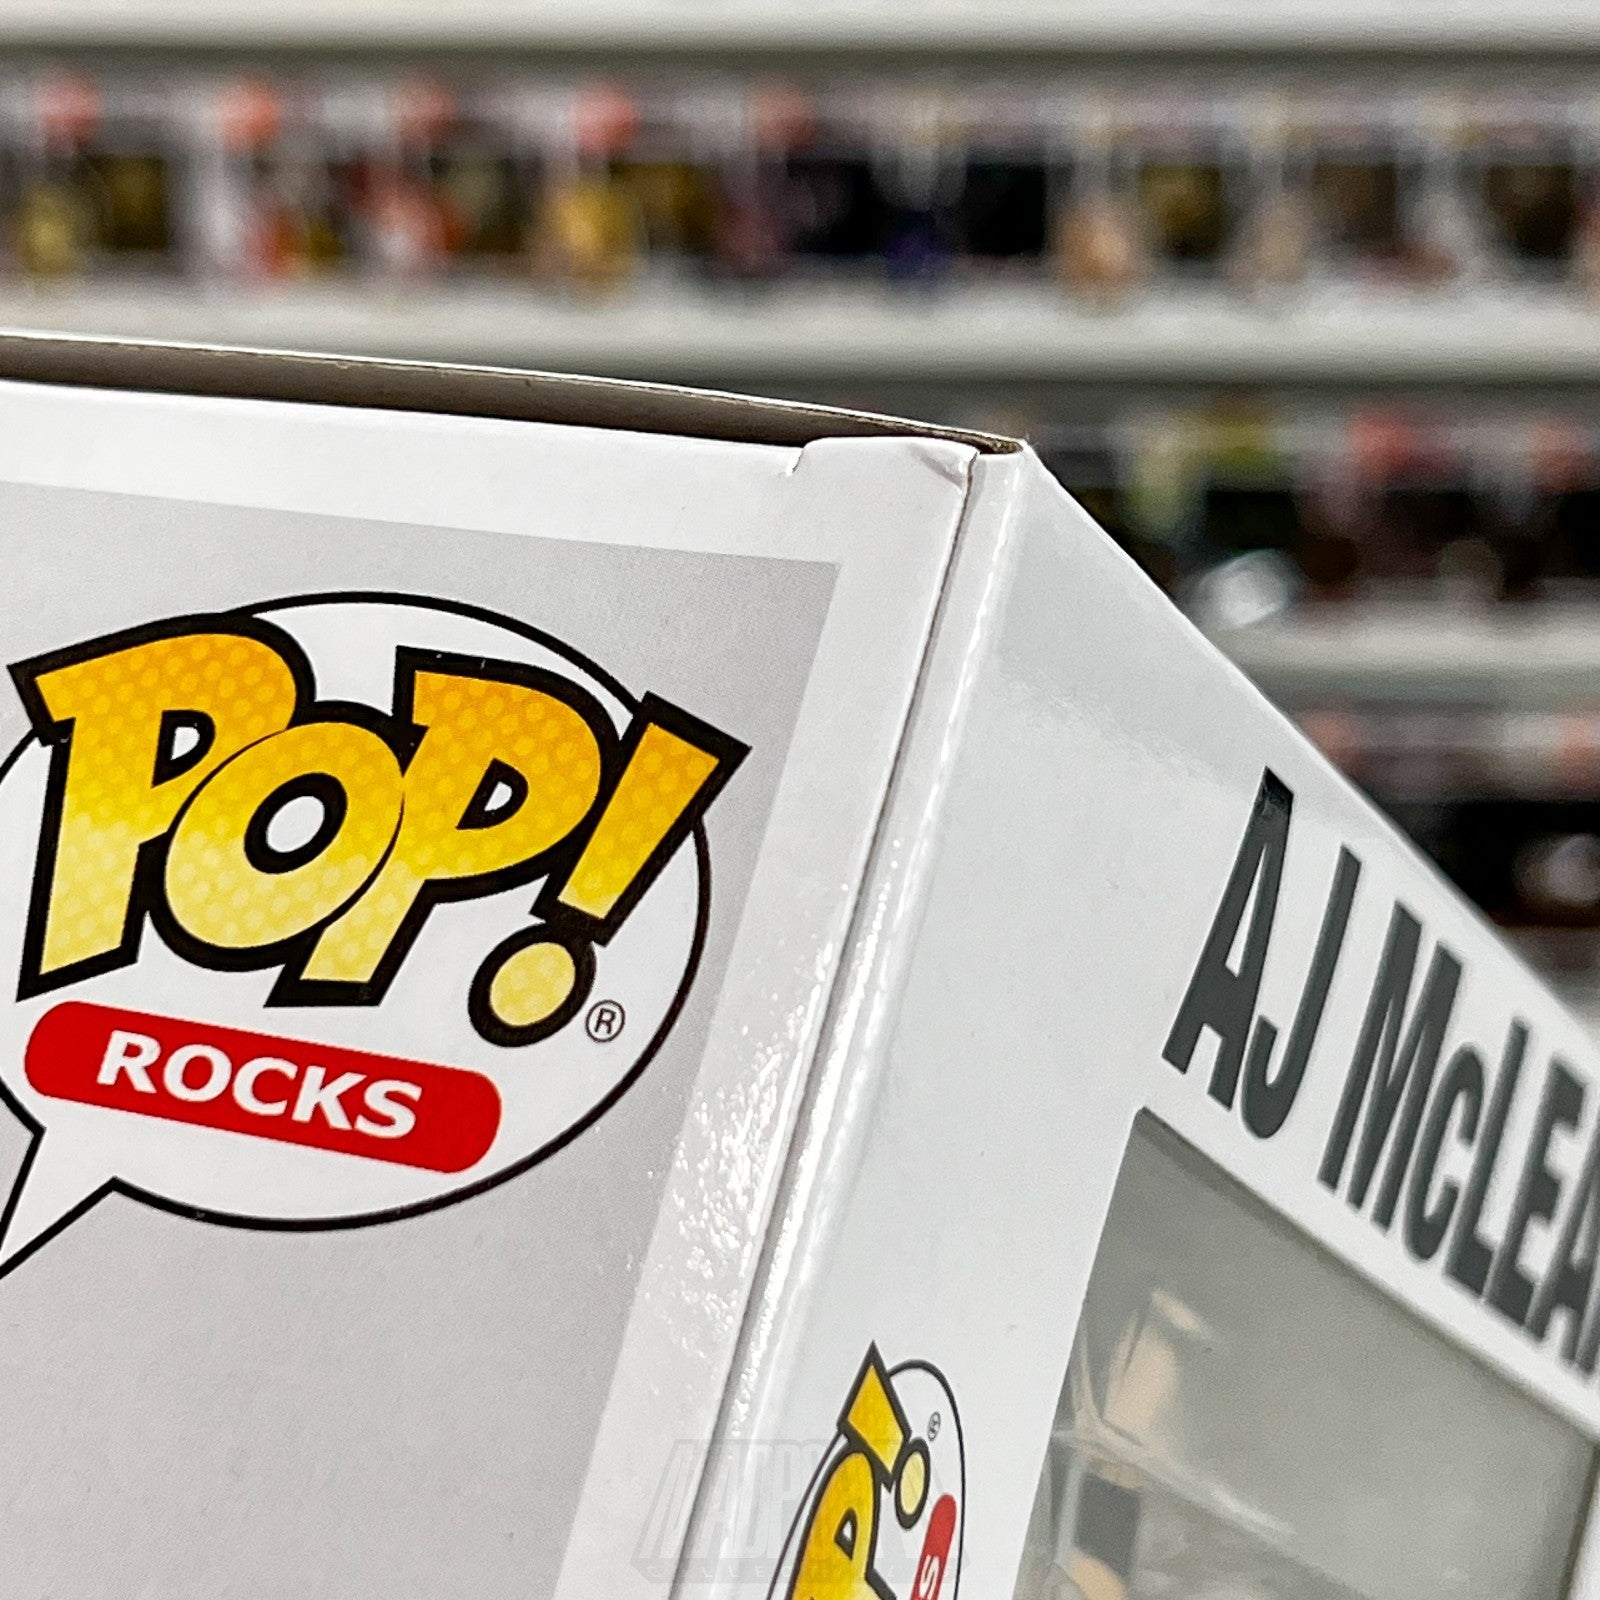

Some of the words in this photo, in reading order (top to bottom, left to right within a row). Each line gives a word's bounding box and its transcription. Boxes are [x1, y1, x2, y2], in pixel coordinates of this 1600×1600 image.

[7, 612, 751, 1047] POP!
[1161, 766, 1361, 1139] AJ
[97, 1030, 423, 1139] ROCKS
